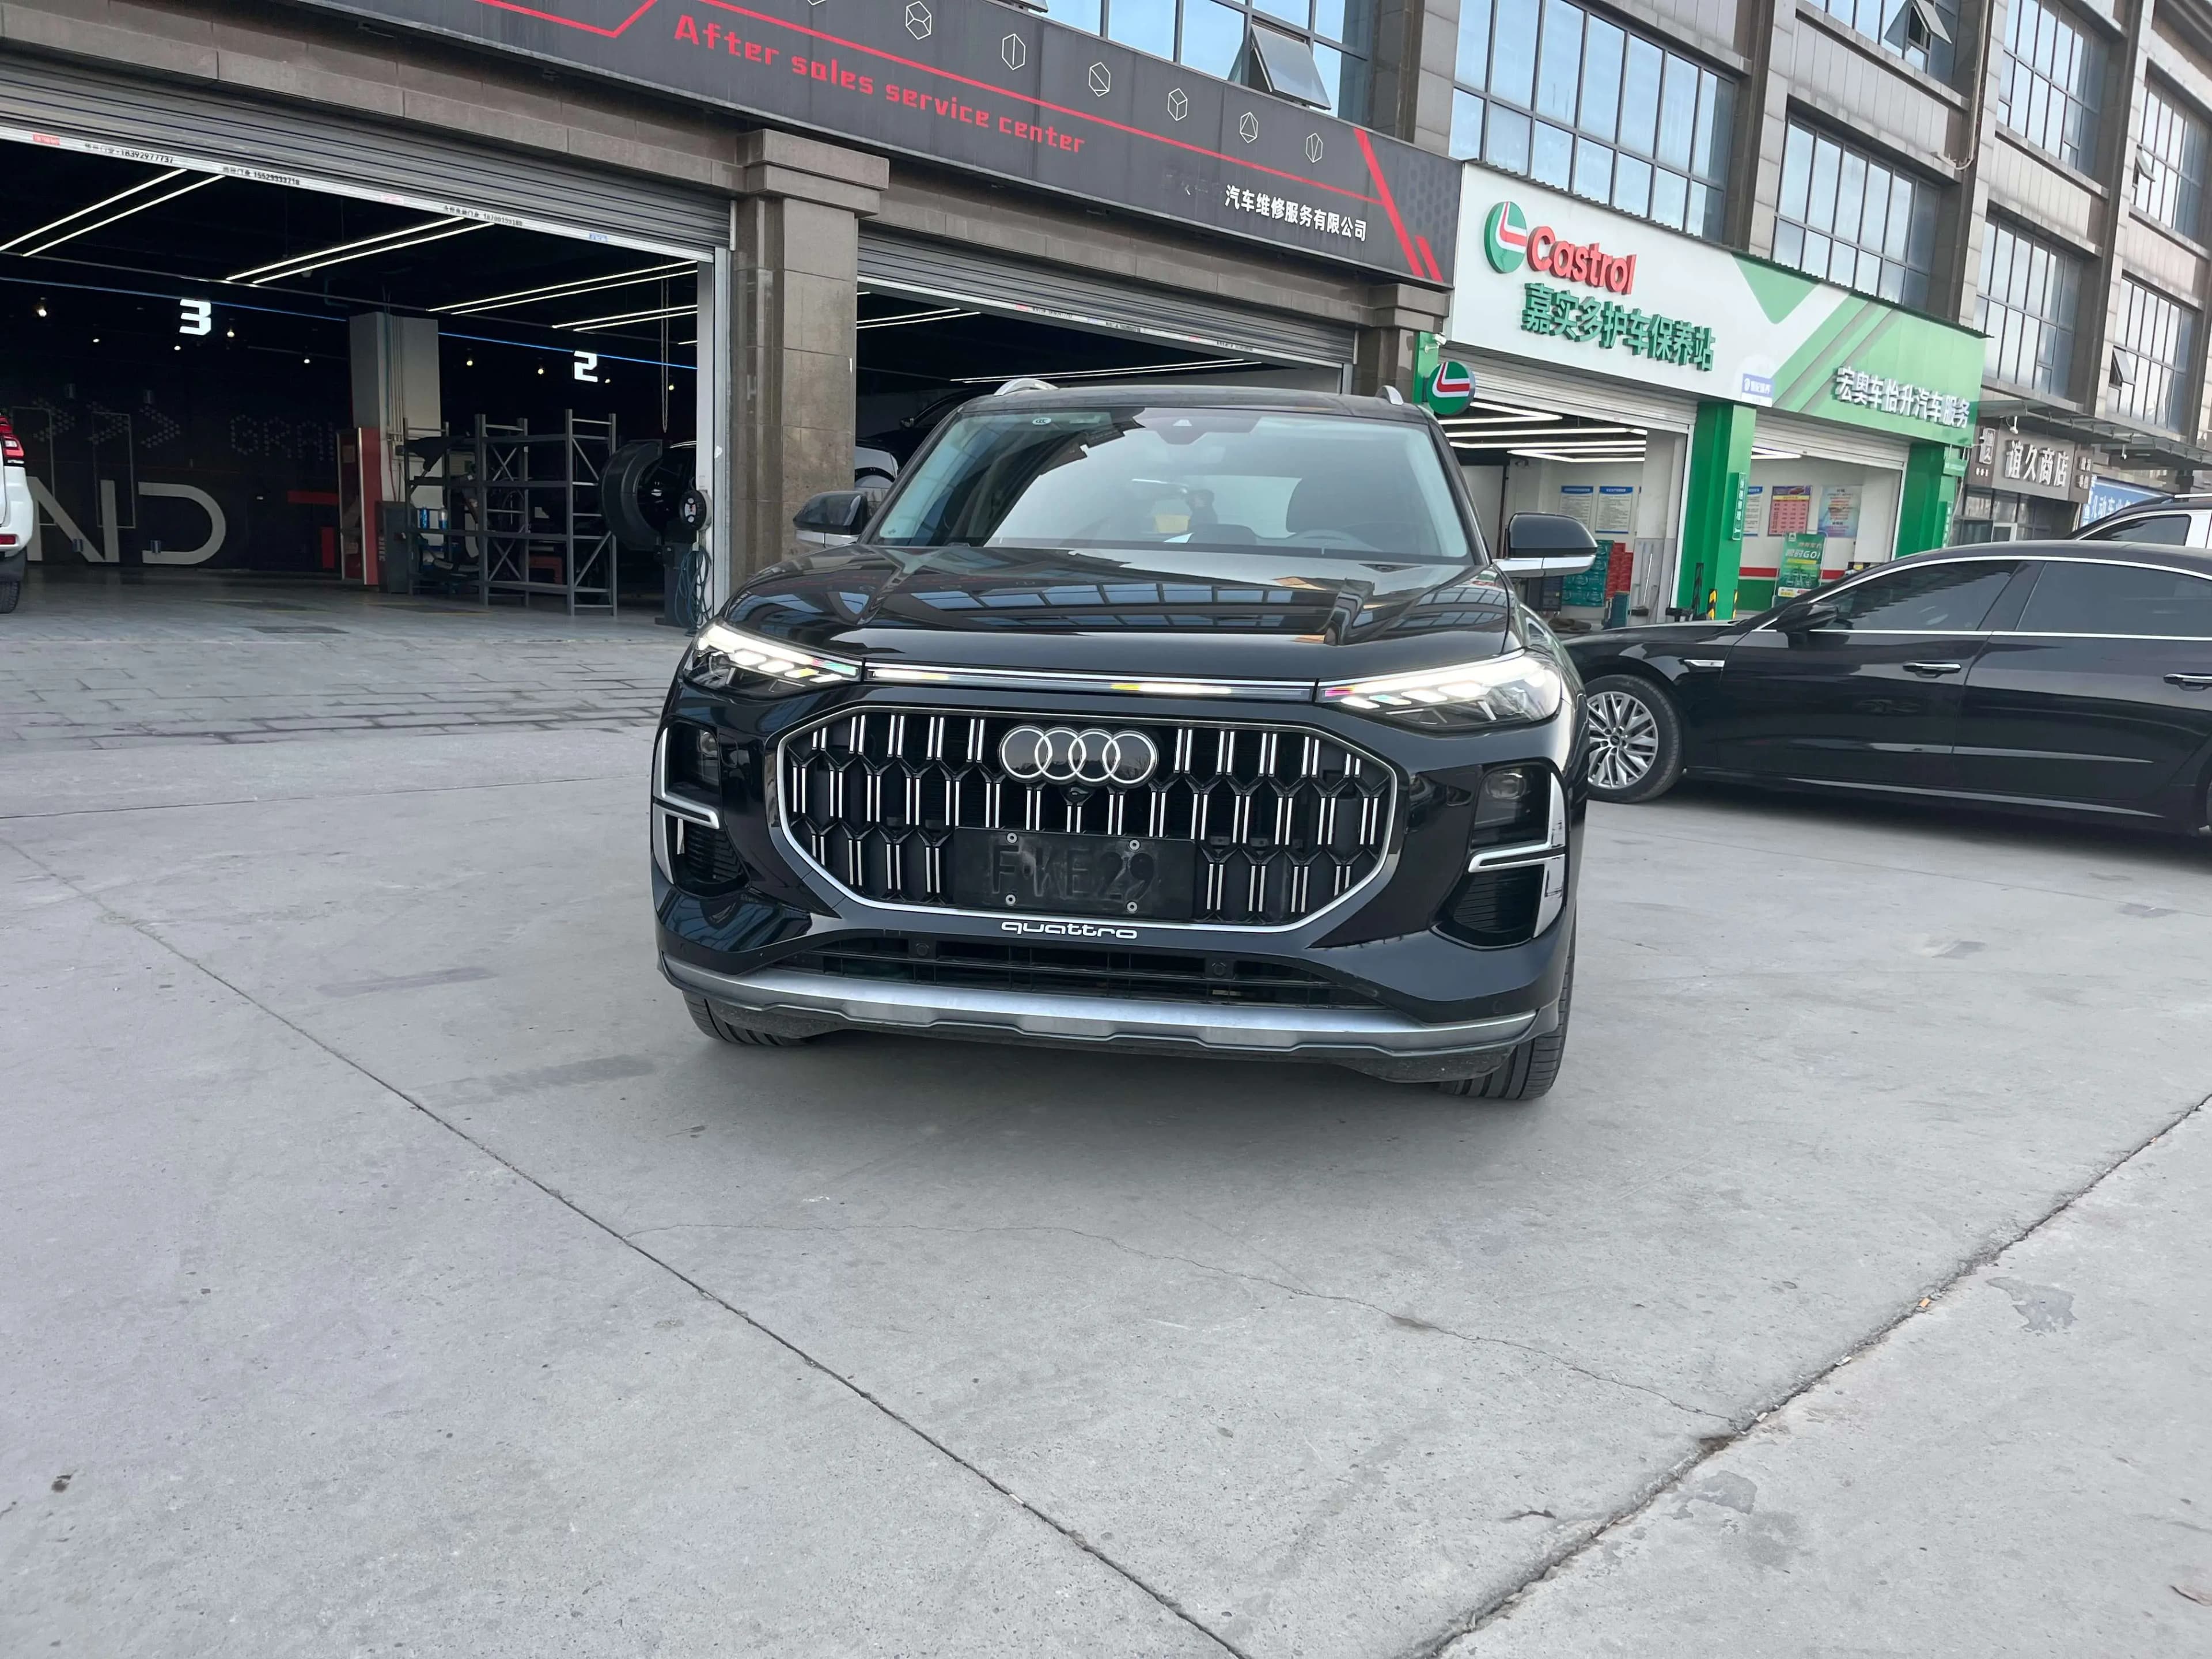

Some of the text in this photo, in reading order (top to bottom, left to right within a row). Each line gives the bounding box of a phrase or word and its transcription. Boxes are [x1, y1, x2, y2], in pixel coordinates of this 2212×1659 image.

[674, 14, 1085, 153] After sales service center
[1224, 184, 1367, 242] 汽车维修服务有限公司
[1527, 226, 1637, 295] Castrol
[179, 298, 212, 336] 3
[1521, 283, 1716, 371] 嘉实多护车保养站
[574, 350, 599, 382] 2
[2005, 440, 2069, 487] 谊久商店
[1001, 921, 1138, 940] quattro
